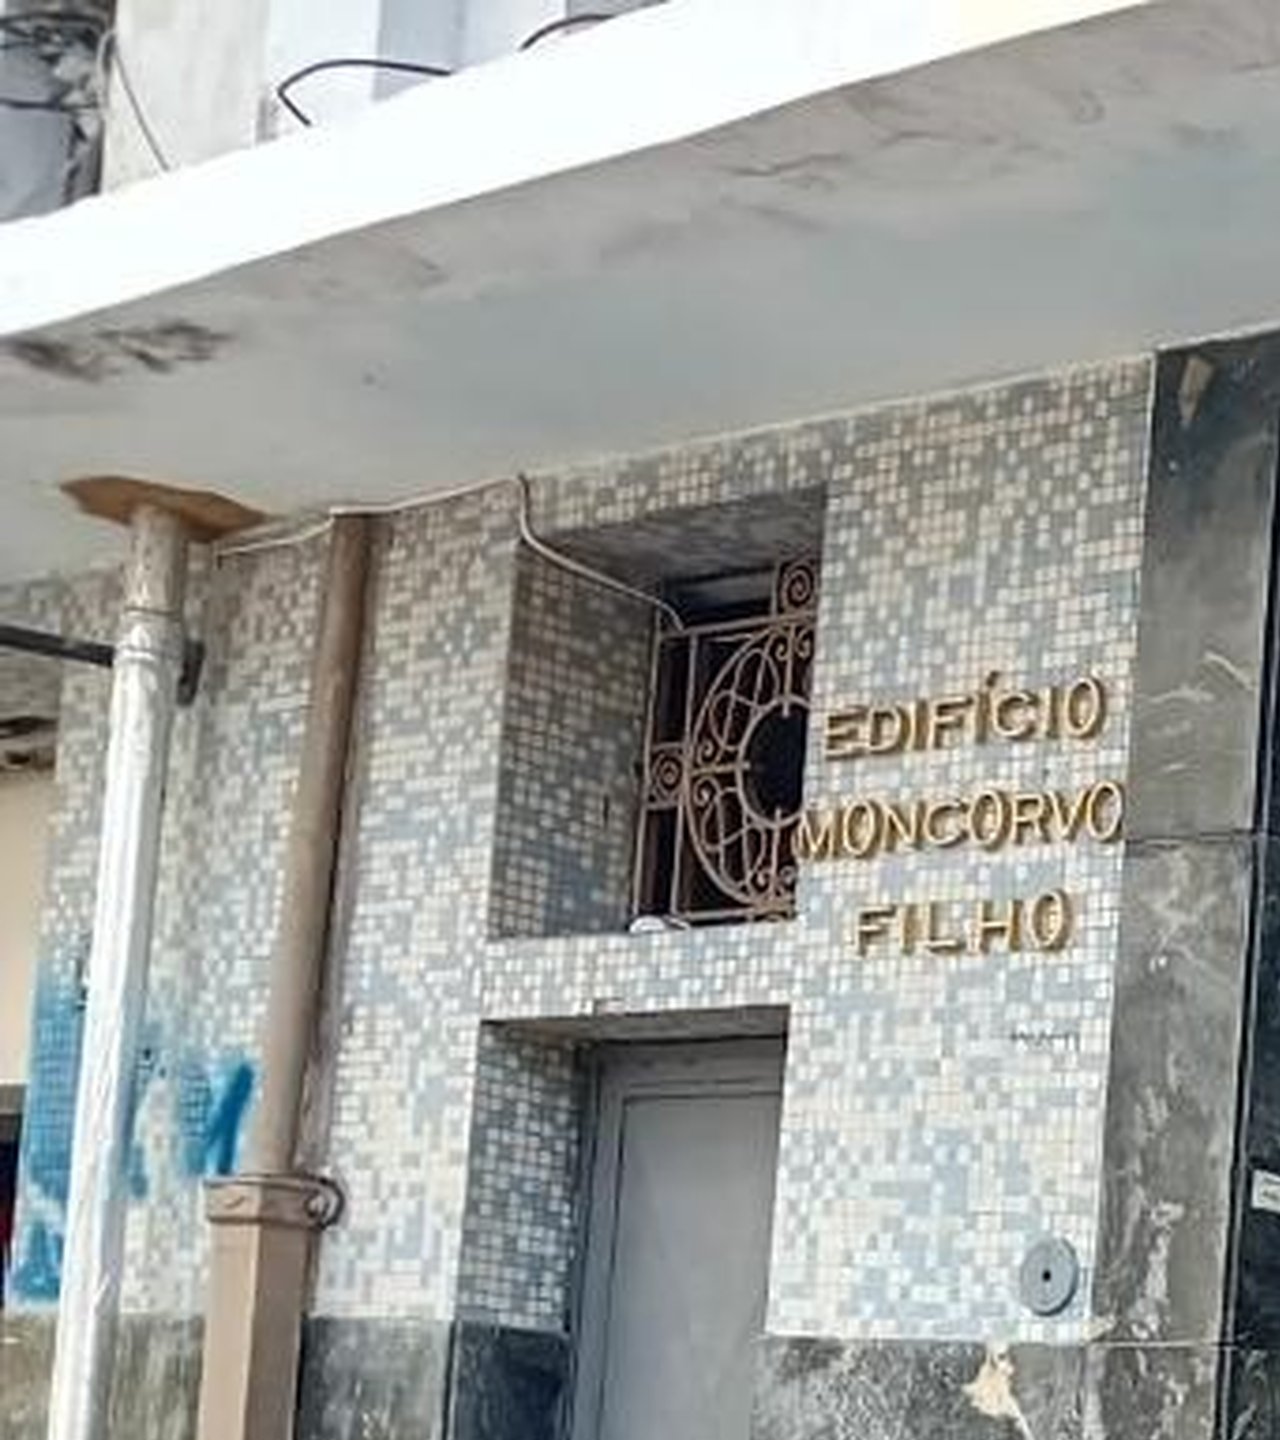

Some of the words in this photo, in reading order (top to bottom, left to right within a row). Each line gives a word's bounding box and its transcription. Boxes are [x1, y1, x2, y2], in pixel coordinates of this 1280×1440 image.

[825, 671, 1106, 761] EDIFÍCIO
[793, 782, 1126, 862] MONCORVO
[854, 888, 1073, 957] FILHO
